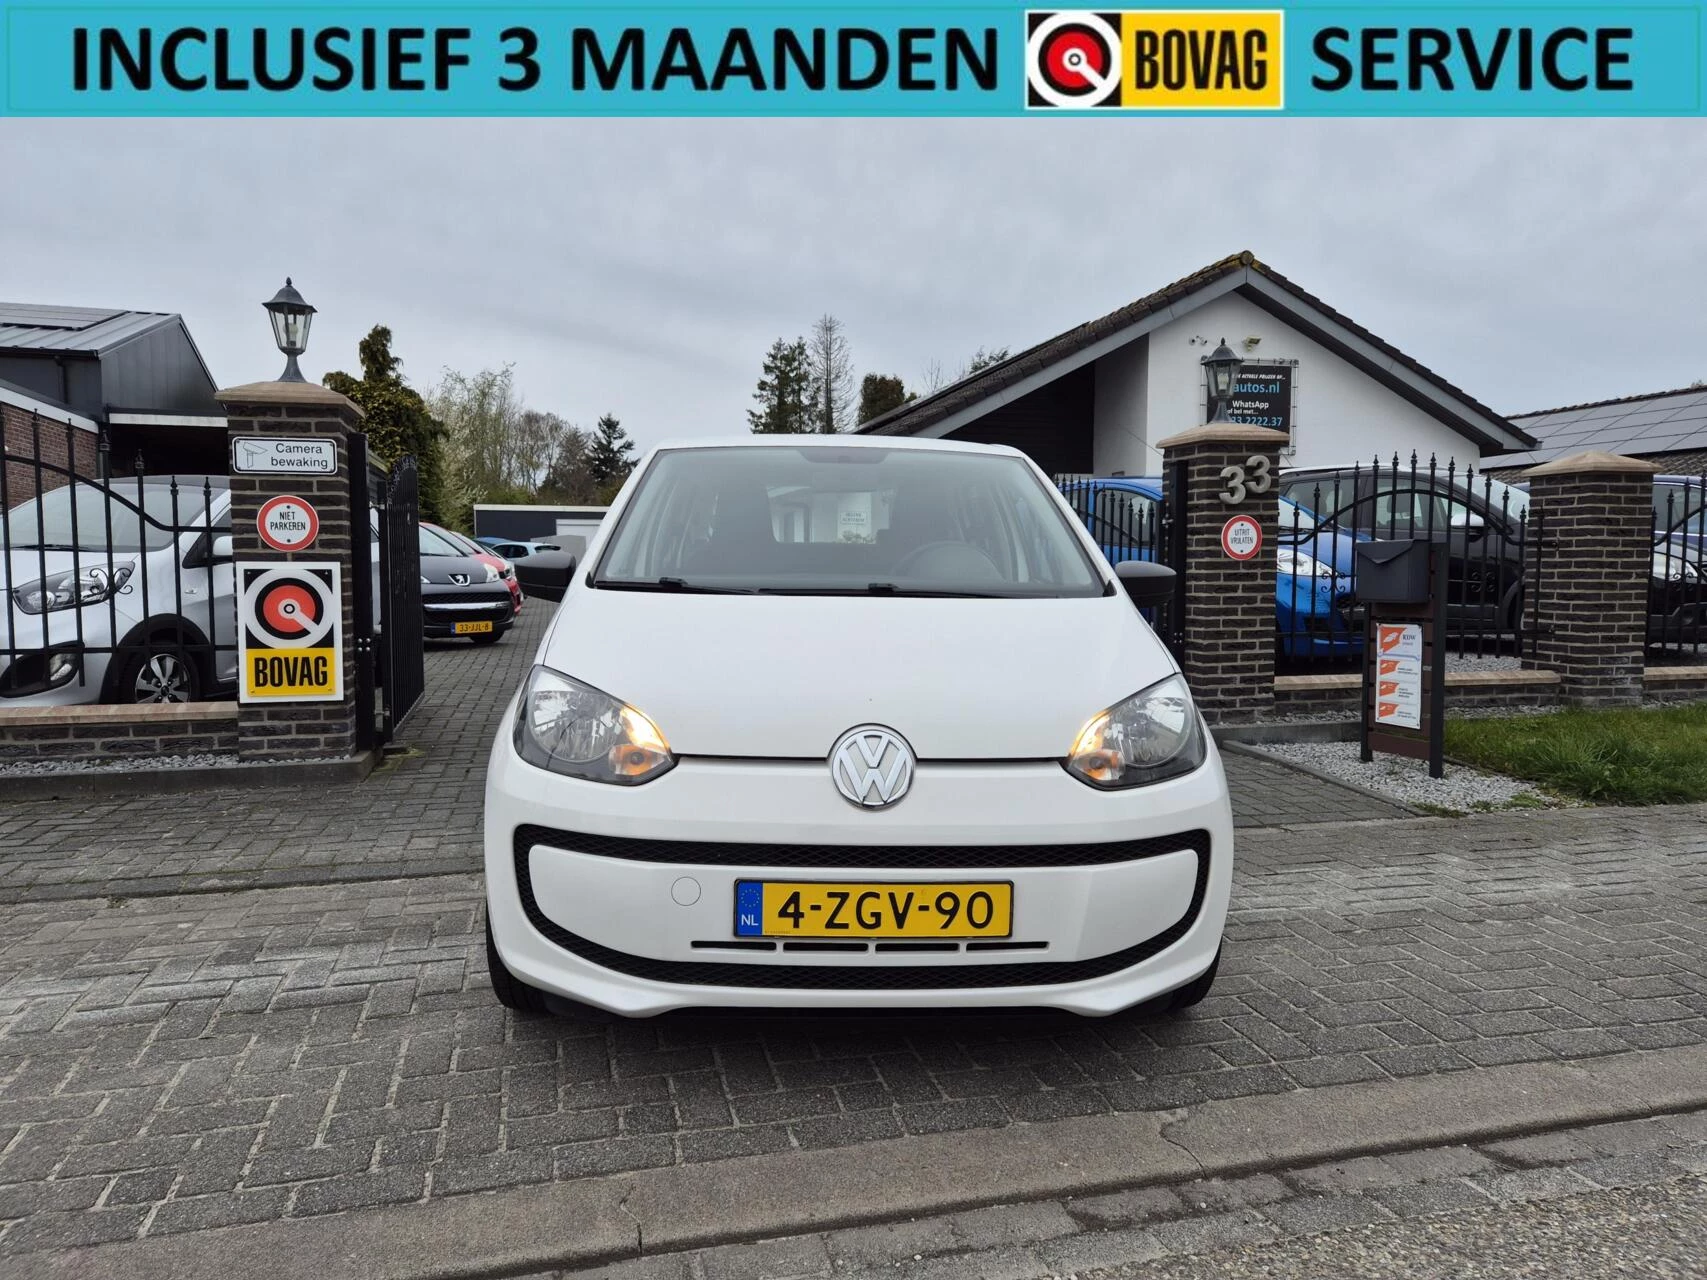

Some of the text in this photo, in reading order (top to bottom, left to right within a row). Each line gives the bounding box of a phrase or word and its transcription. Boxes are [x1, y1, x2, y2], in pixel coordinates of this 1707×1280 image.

[1232, 400, 1269, 410] WhatsApp
[275, 443, 323, 454] Camera
[271, 456, 328, 469] bewaking
[1219, 454, 1272, 505] 33
[279, 511, 295, 521] NIET
[270, 521, 306, 531] PARKEREN
[1234, 528, 1250, 536] UITRIT
[254, 656, 328, 688] BOVAG
[741, 890, 994, 930] NL 4-ZGV-90
